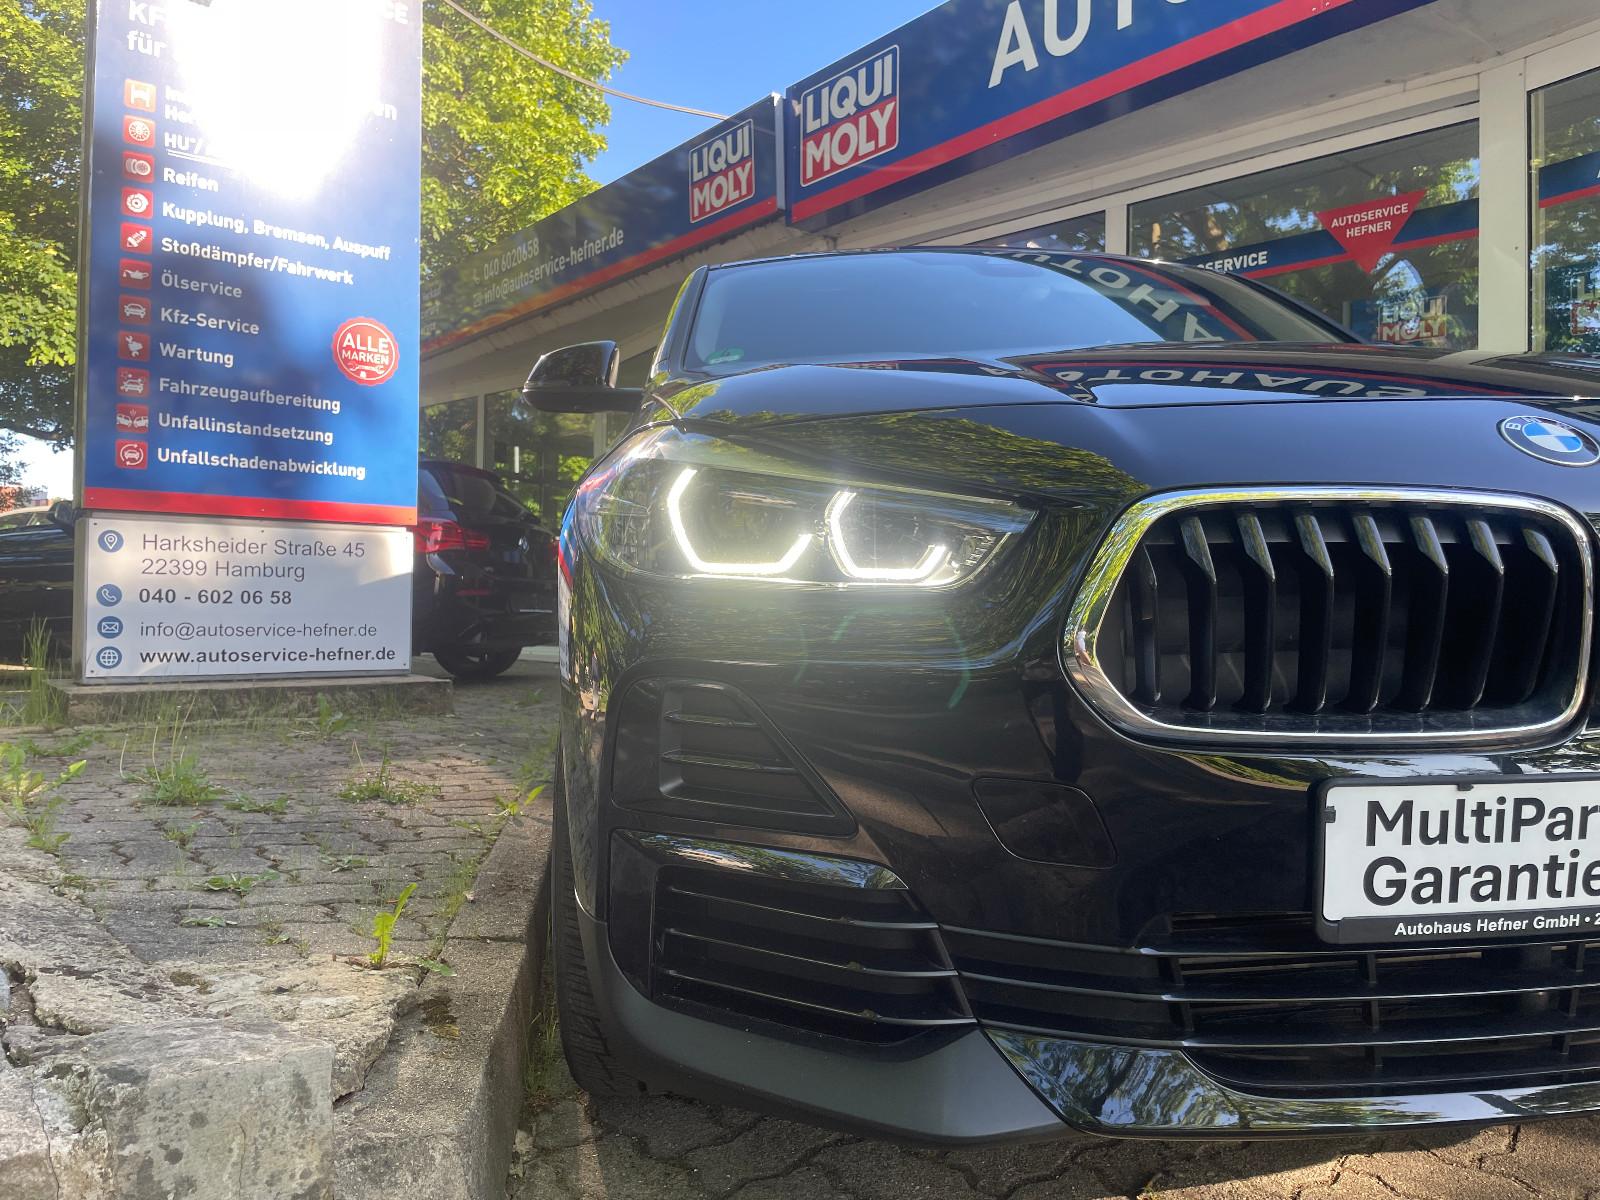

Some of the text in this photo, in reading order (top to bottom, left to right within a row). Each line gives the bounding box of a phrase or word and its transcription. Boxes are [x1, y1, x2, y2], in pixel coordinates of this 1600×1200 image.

[127, 30, 167, 57] für
[988, 0, 1188, 88] AU
[806, 54, 894, 134] LIQUI
[806, 101, 896, 179] MOLY
[691, 125, 750, 182] LIQUI
[163, 167, 219, 192] Reifen
[692, 160, 753, 218] MOLY
[1331, 203, 1409, 228] AUTOSERVICE
[162, 202, 391, 260] Kupplung, Bremsen, Auspuff
[1346, 220, 1392, 238] HEFNER
[161, 237, 354, 285] Stoßdämpfer/Fahrwerk
[1196, 251, 1268, 272] SERVICE
[160, 270, 243, 298] Ölservice
[160, 307, 260, 335] Kfz-Service
[1382, 318, 1442, 342] MOLY
[159, 342, 234, 368] Wartung
[342, 333, 390, 354] ALLE
[341, 350, 390, 365] MARKEN
[158, 378, 341, 414] Fahrzeugaufbereitung
[158, 412, 334, 446] Unfallinstandsetzung
[157, 447, 367, 481] Unfallschadenabwicklung
[142, 533, 366, 558] Harksheider Straße 45
[141, 558, 305, 583] 22399 Hamburg
[138, 588, 177, 604] 040
[197, 589, 233, 605] 602
[240, 589, 263, 605] 06
[269, 590, 292, 605] 58
[139, 620, 378, 640] info@autoservice-hefner.de
[139, 646, 396, 664] www.autoservice-hefner.de
[1365, 796, 1600, 847] MultiPar
[1394, 921, 1471, 936] Autohaus
[1476, 917, 1529, 932] Hefner
[1533, 914, 1580, 929] GmbH
